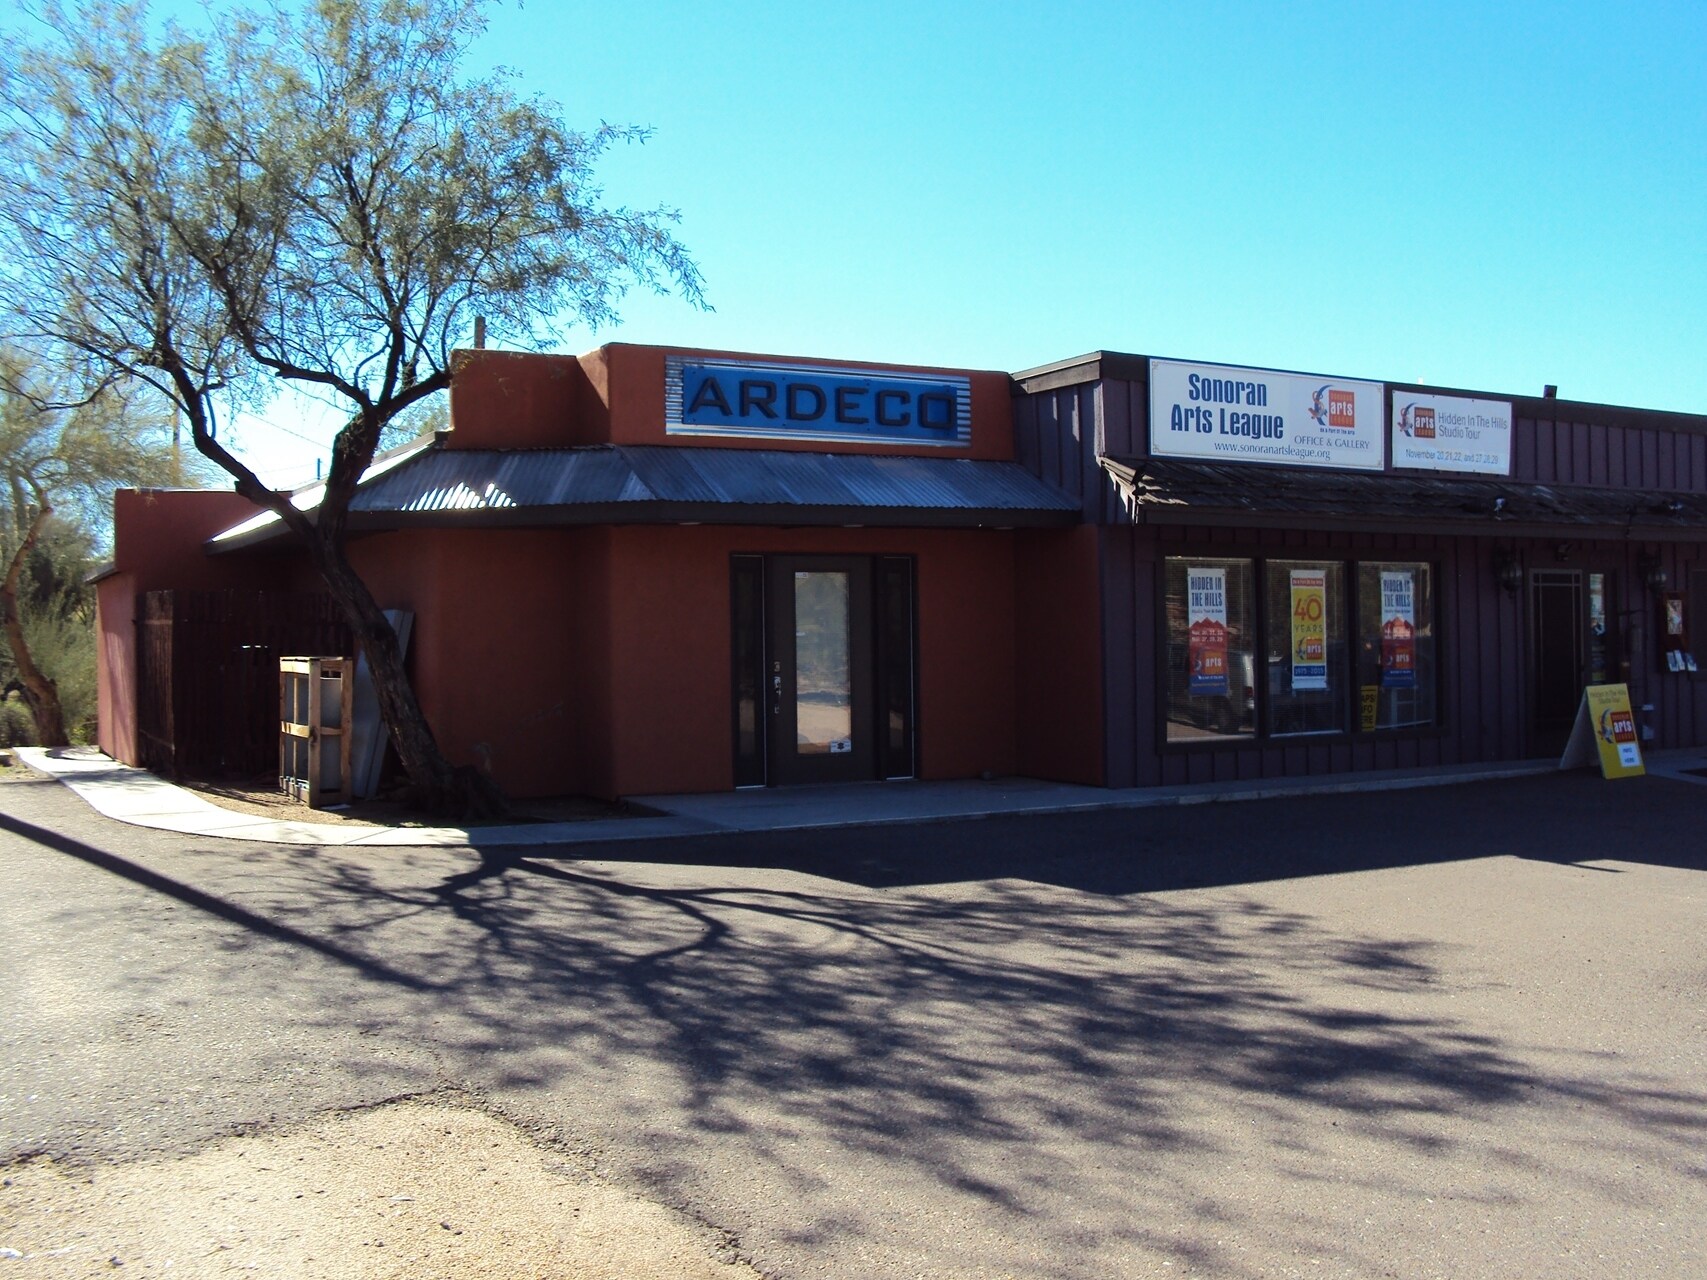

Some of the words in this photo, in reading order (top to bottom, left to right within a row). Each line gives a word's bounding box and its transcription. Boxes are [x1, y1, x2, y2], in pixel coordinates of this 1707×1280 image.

[1188, 373, 1267, 407] Sonoran
[688, 376, 955, 430] ARDECO
[1330, 401, 1353, 417] arts
[1171, 403, 1213, 434] Arts
[1220, 407, 1284, 439] League
[1415, 416, 1434, 429] arts
[1438, 412, 1466, 425] Hidden
[1476, 415, 1489, 428] The
[1491, 416, 1507, 430] Hills
[1438, 425, 1464, 438] Studio
[1464, 427, 1481, 440] Tour
[1294, 435, 1324, 447] OFFICE
[1326, 438, 1332, 447] &
[1335, 438, 1370, 450] GALLERY
[1214, 442, 1331, 461] www.sonoranartsleague.org
[1405, 449, 1436, 460] November
[1190, 577, 1214, 590] HIDDEN
[1214, 577, 1222, 590] IN
[1191, 592, 1203, 606] THE
[1204, 593, 1223, 606] HILLS
[1384, 594, 1394, 607] THE
[1395, 594, 1411, 607] HILLS
[1293, 596, 1322, 621] 40
[1295, 624, 1323, 633] YEARS
[1205, 658, 1222, 668] arts
[1613, 720, 1632, 733] arts
